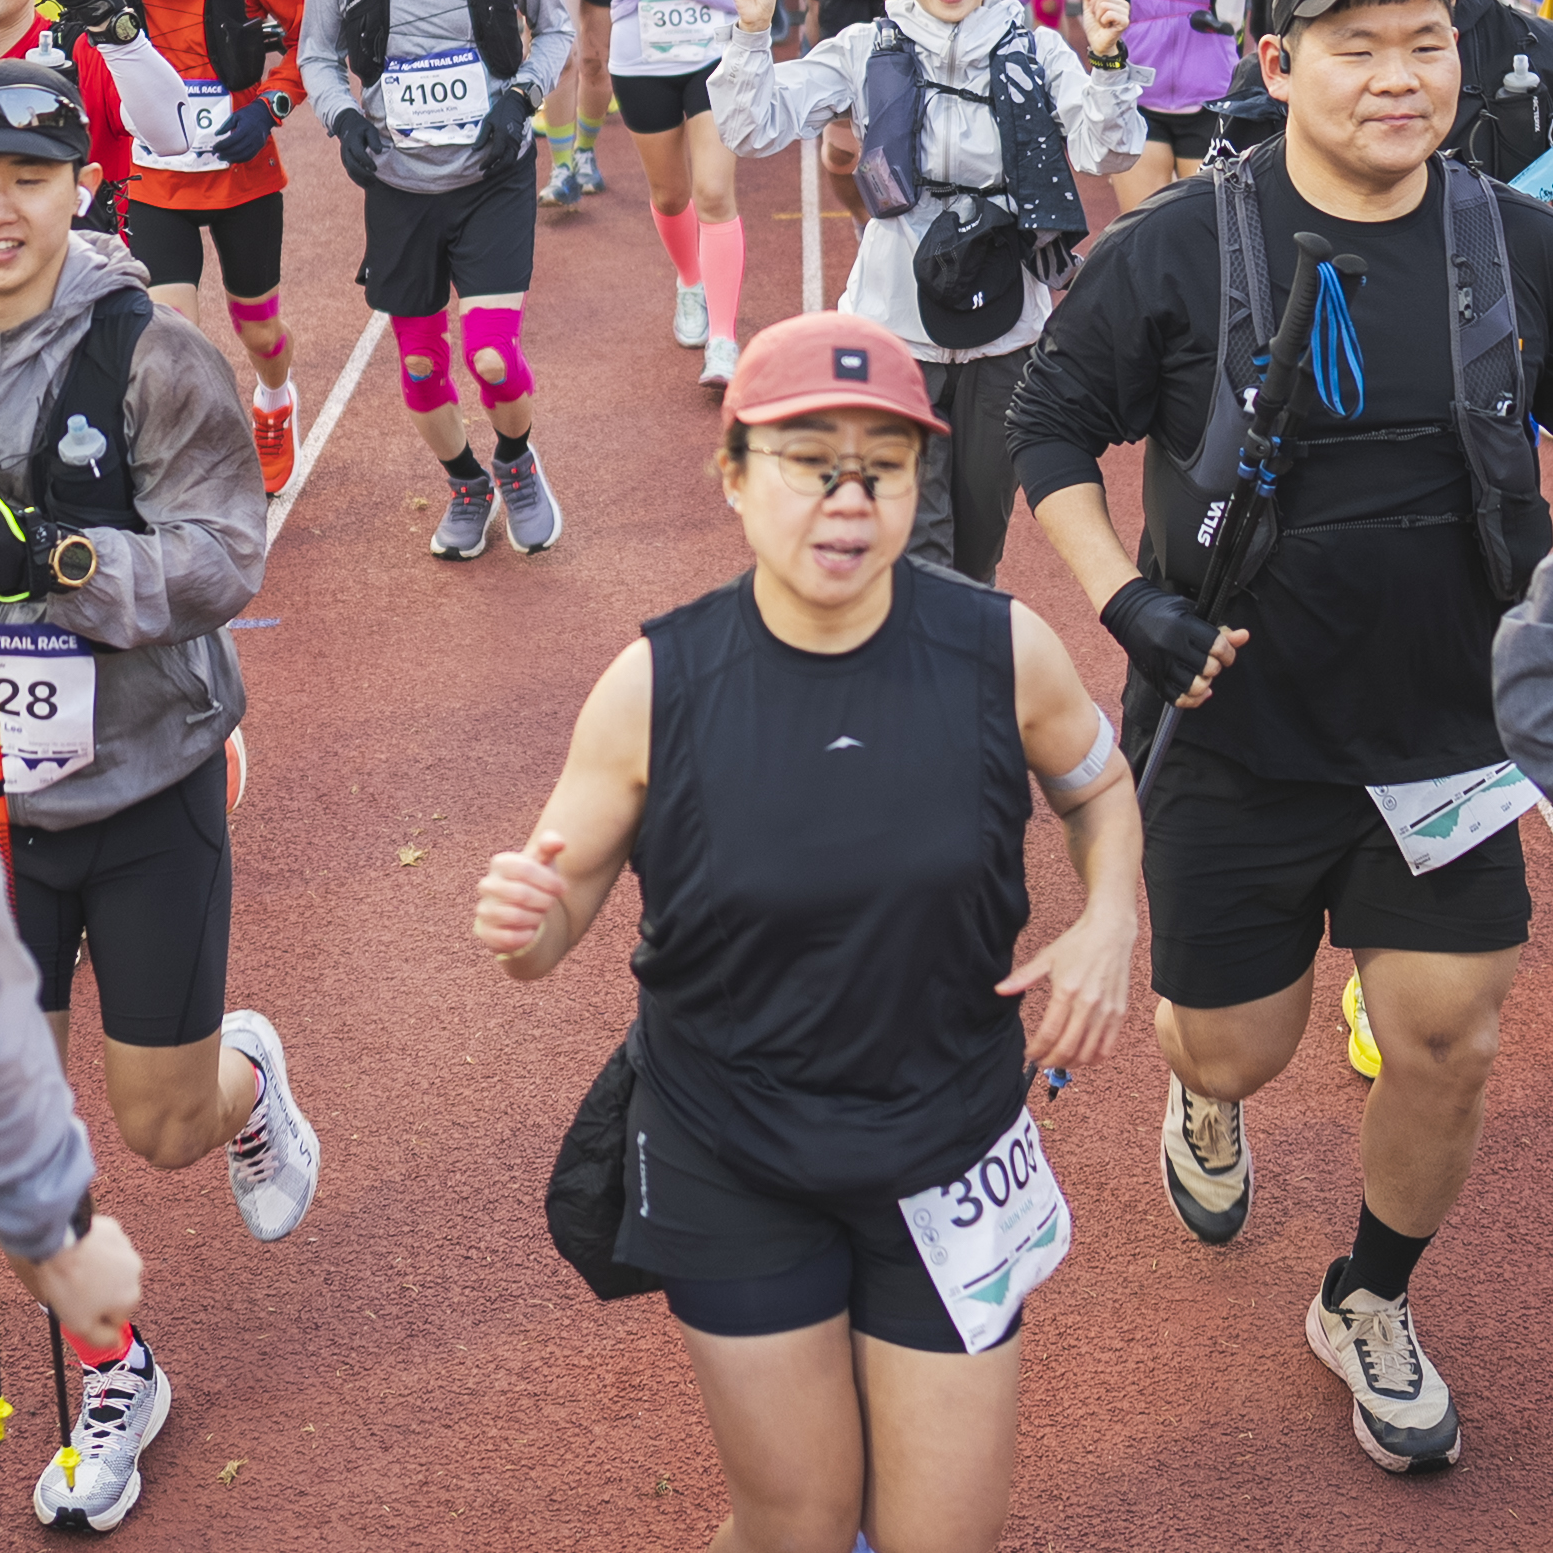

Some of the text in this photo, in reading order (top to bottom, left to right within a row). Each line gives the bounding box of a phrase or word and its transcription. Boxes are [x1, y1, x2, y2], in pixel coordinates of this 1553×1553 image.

[653, 5, 712, 27] 3036
[430, 57, 453, 68] TRAIL
[453, 52, 474, 63] RACE
[202, 85, 222, 94] RACE
[400, 78, 468, 107] 4100
[37, 635, 78, 650] RACE
